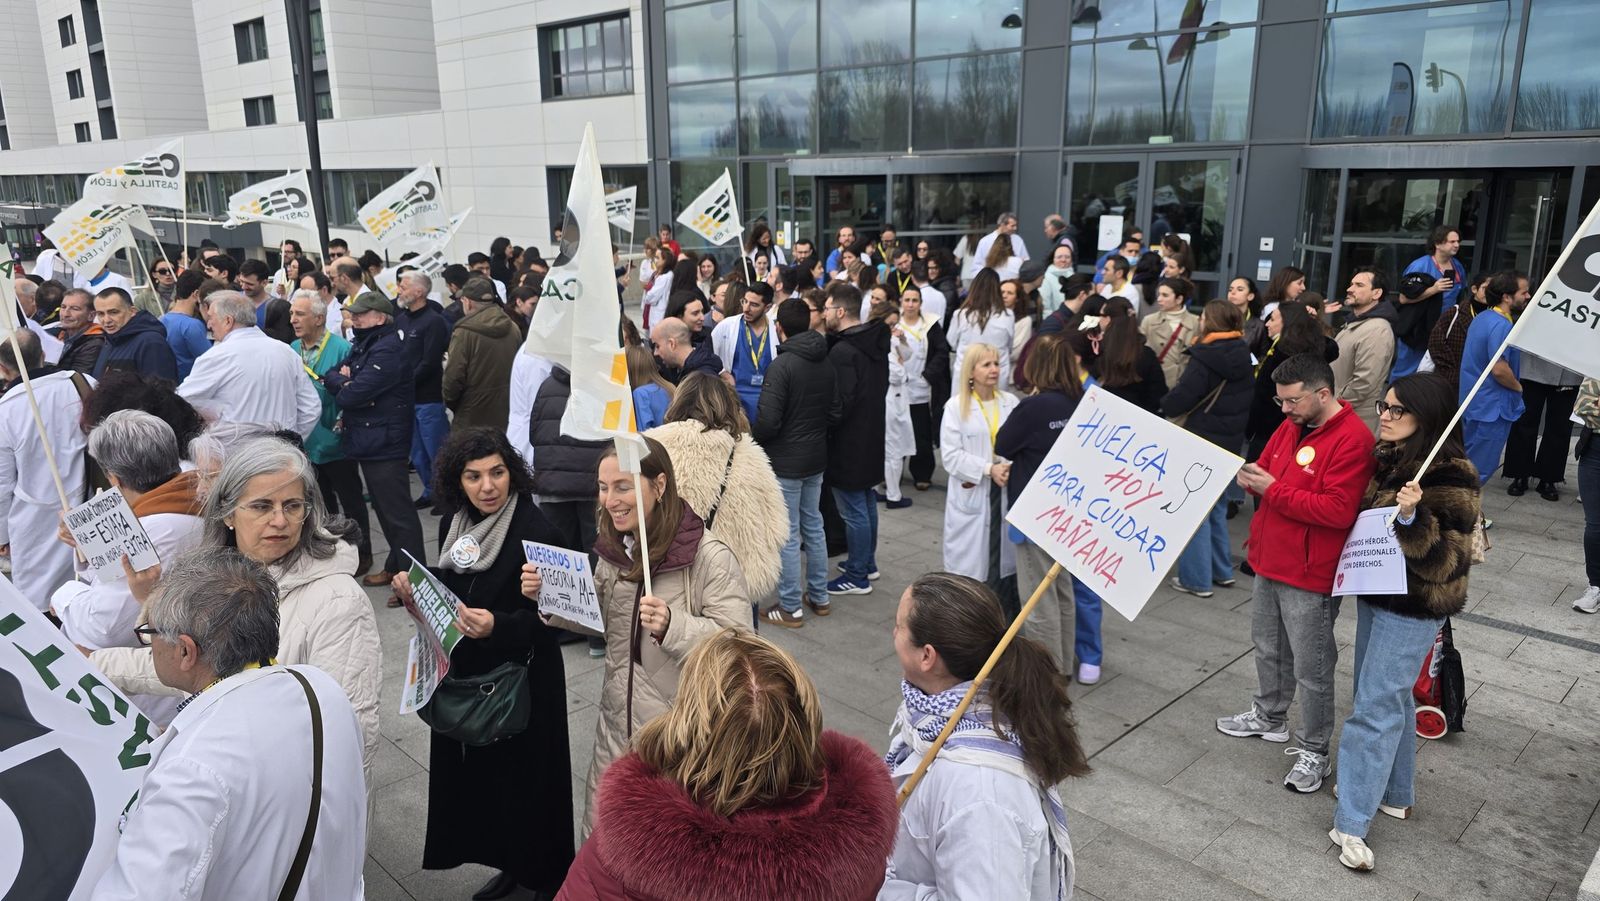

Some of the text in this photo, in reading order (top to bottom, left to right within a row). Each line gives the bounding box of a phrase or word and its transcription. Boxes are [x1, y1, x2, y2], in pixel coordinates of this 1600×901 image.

[1077, 408, 1169, 482] HUELGA
[1104, 467, 1163, 510] HOY
[95, 511, 133, 544] ESTAFA
[1039, 463, 1167, 572] PARA CUIDAR
[90, 555, 107, 570] SON
[123, 532, 152, 557] EXTRA
[525, 544, 570, 570] QUEREMOS
[1035, 505, 1125, 588] MAÑANA
[1351, 547, 1397, 558] PROFESIONALES
[1352, 560, 1384, 569] DERECHOS.
[417, 577, 454, 630] HUELGA
[543, 593, 561, 609] AÑOS
